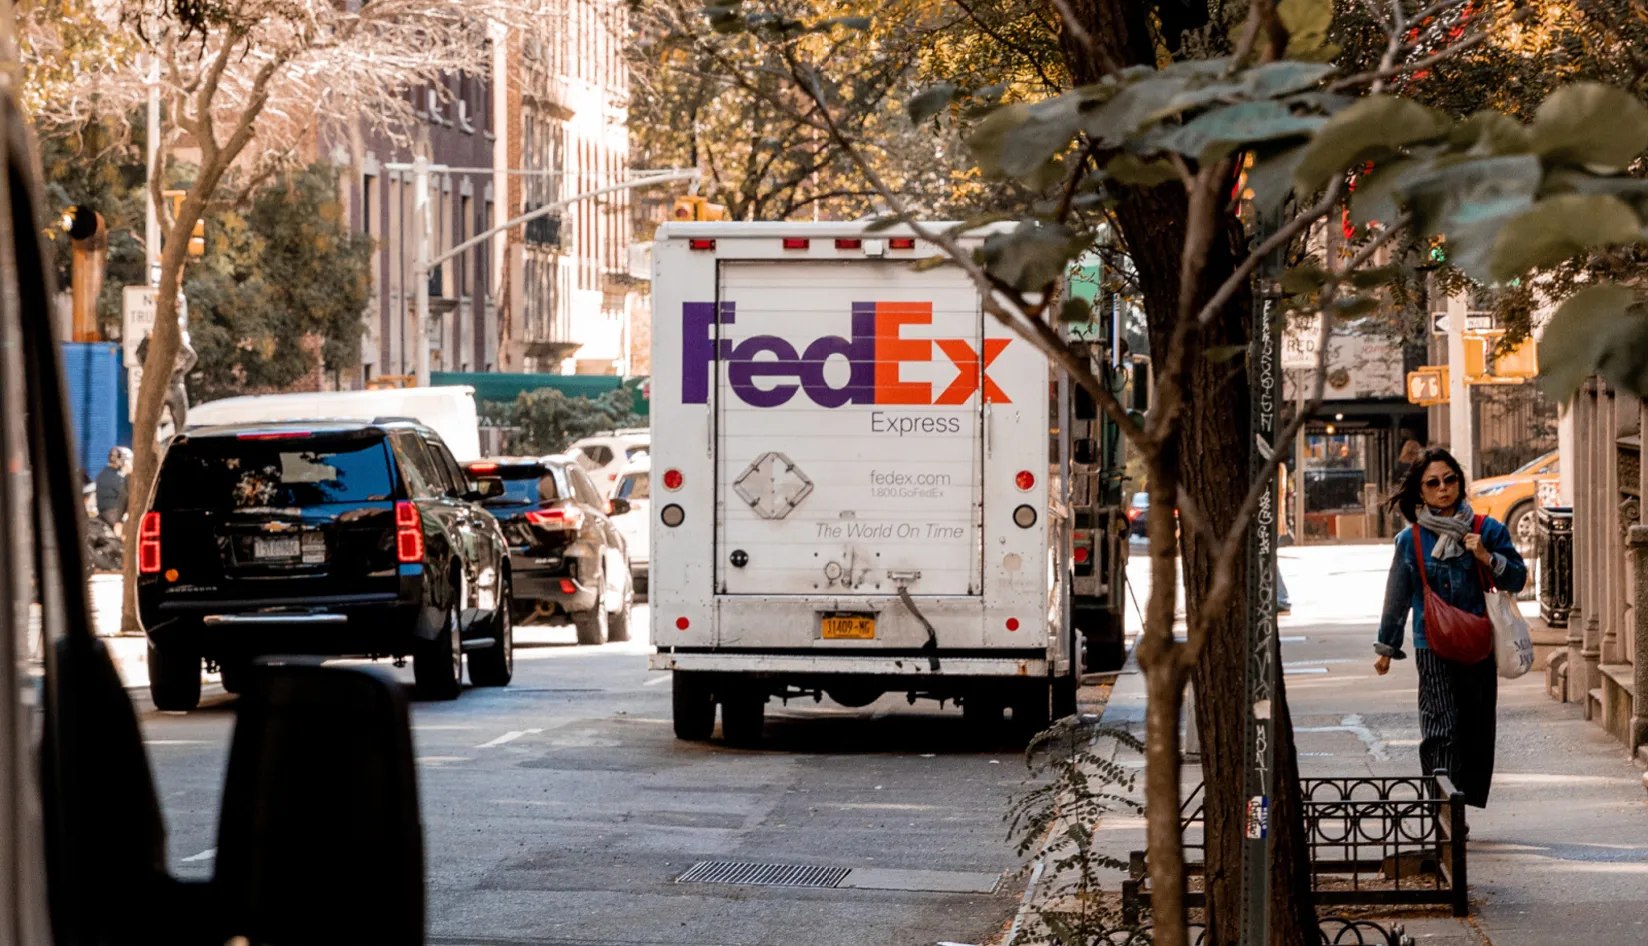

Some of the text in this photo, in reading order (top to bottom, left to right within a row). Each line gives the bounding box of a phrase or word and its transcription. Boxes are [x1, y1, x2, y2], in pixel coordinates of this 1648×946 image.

[1287, 339, 1315, 353] RED
[682, 301, 1014, 408] FedEx
[871, 411, 960, 437] Express
[870, 469, 951, 485] fedex.com
[815, 522, 964, 538] The World On Time
